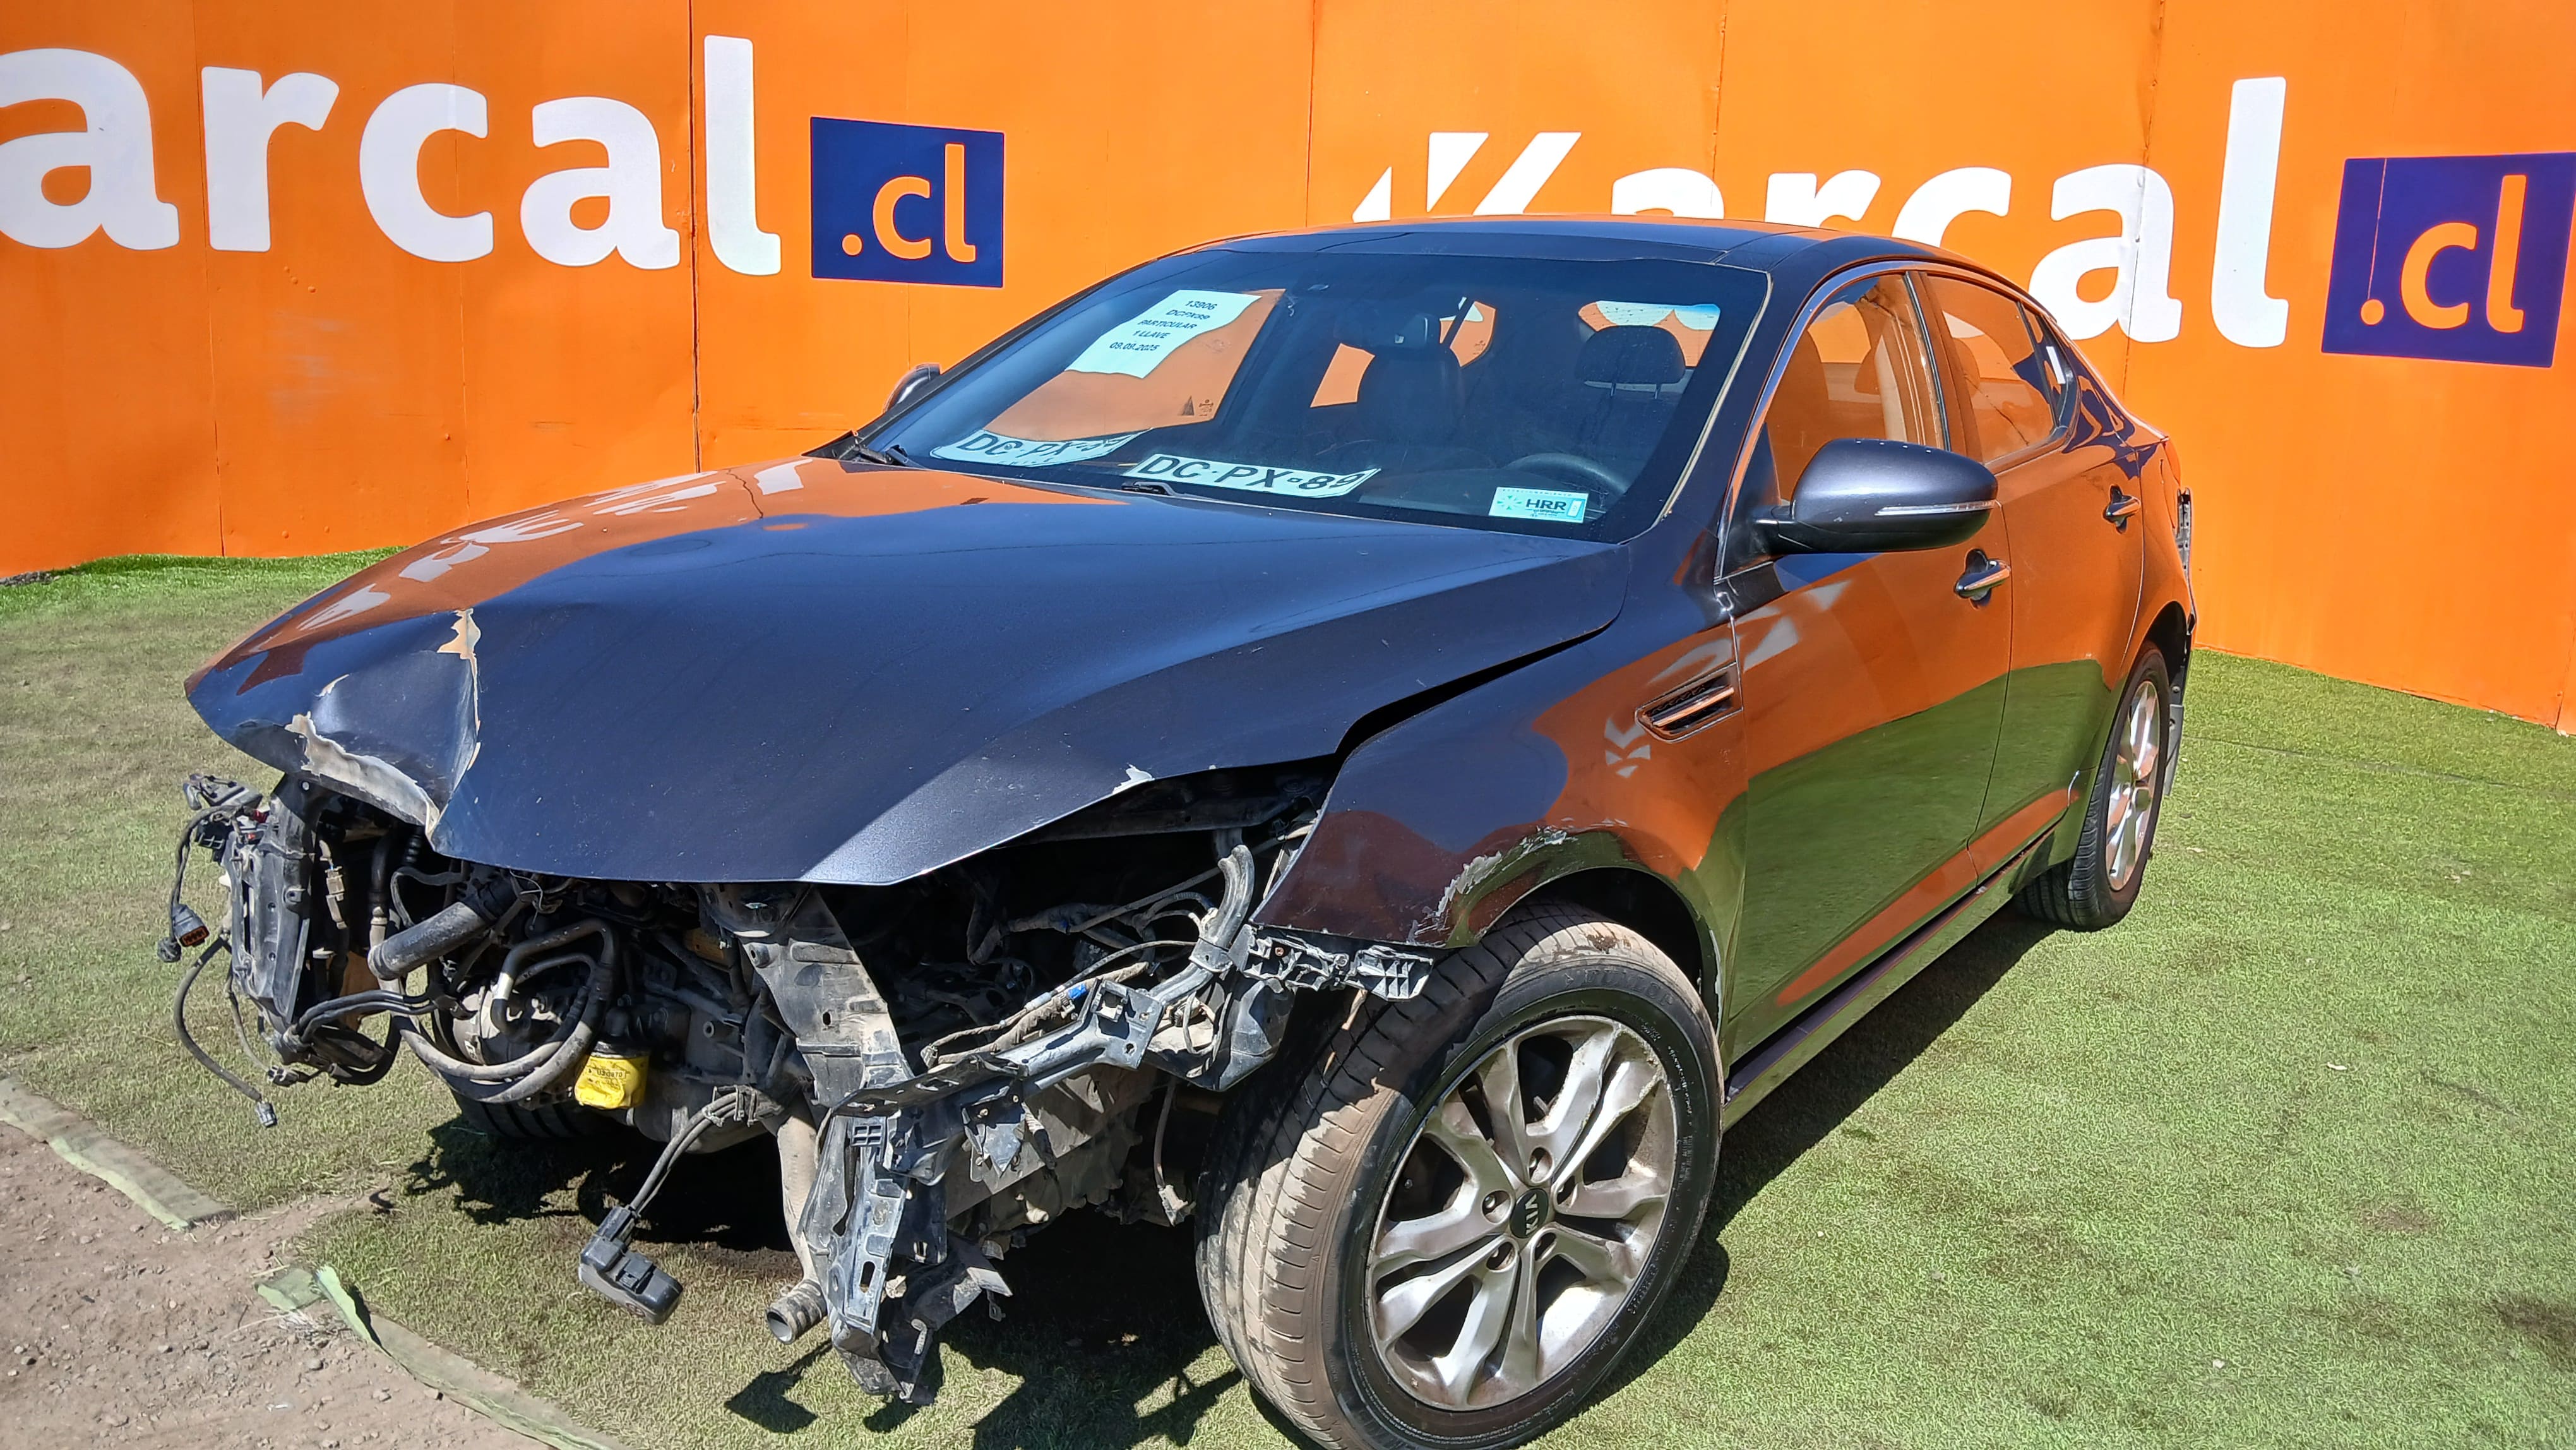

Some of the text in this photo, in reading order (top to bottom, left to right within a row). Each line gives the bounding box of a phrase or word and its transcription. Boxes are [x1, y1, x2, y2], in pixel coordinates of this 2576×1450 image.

[841, 143, 977, 263] .cl
[2360, 174, 2525, 333] .cl
[1185, 301, 1217, 309] 13906
[1137, 320, 1197, 328] PARTICULAR
[1138, 330, 1171, 339] LLAVE
[1525, 498, 1567, 511] HRR
[1525, 1193, 1539, 1235] KIA
